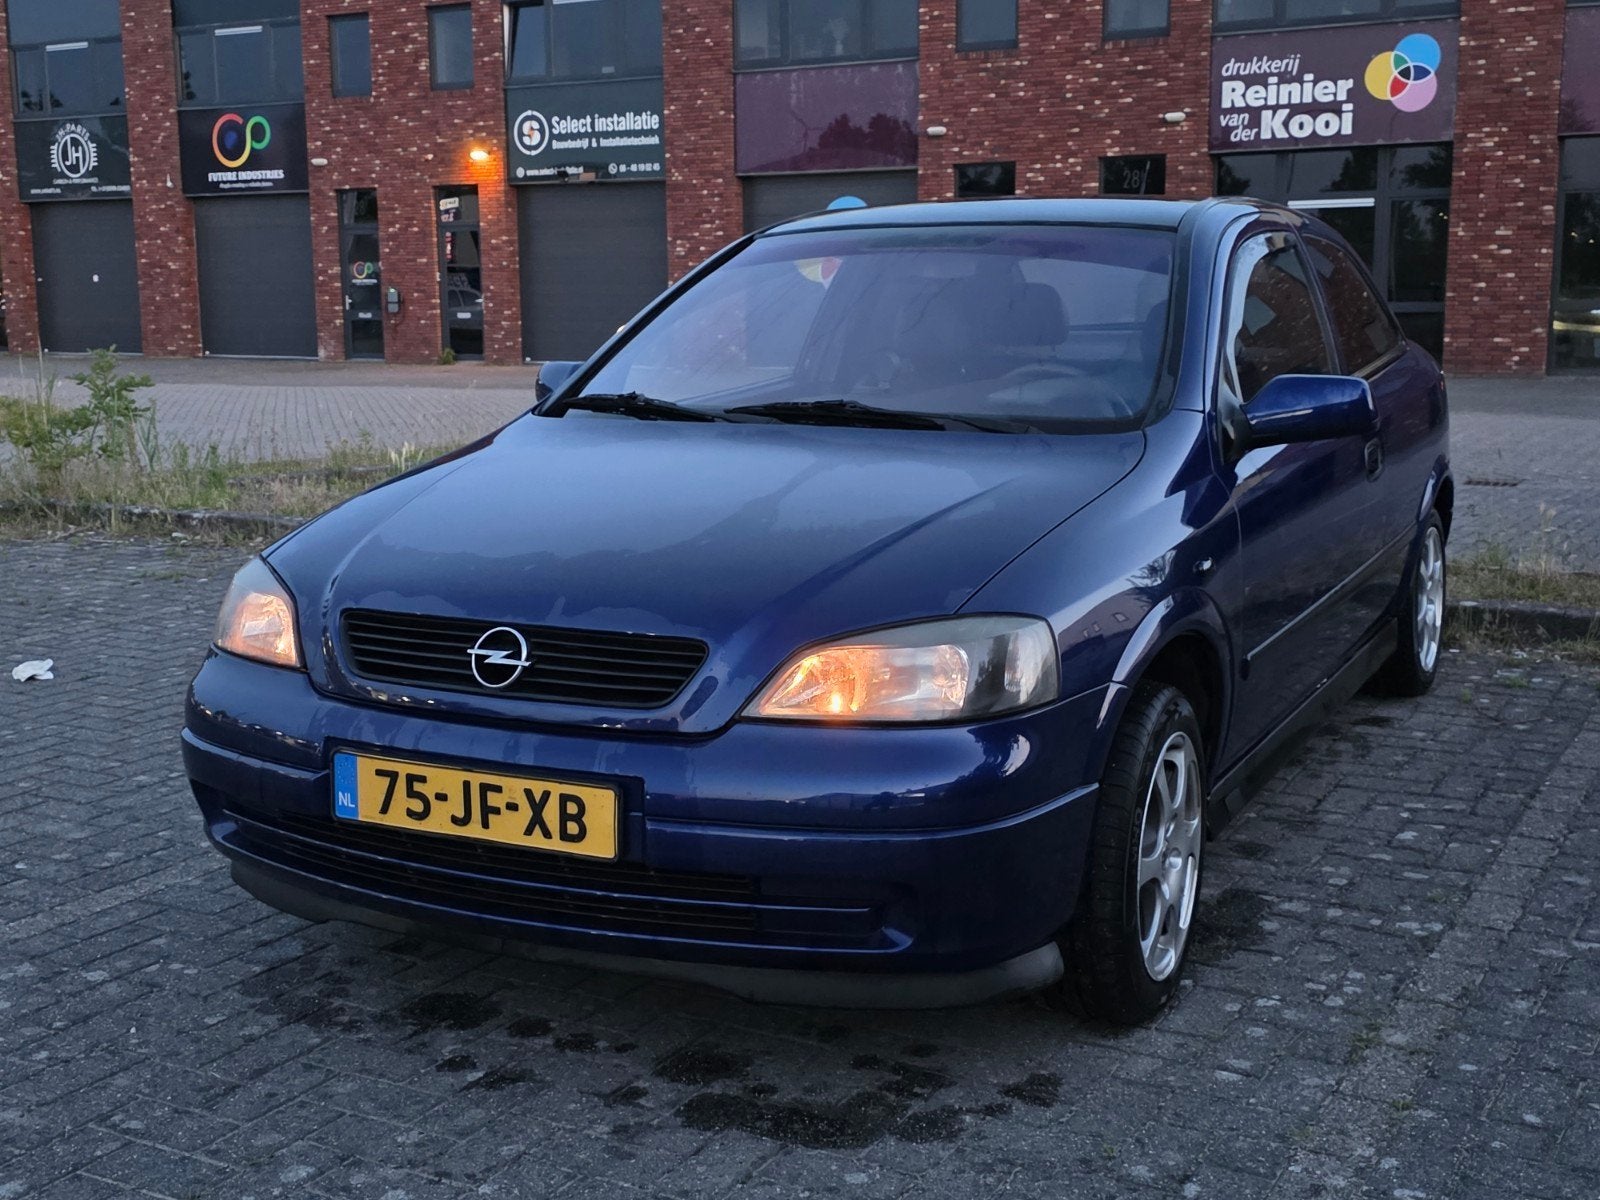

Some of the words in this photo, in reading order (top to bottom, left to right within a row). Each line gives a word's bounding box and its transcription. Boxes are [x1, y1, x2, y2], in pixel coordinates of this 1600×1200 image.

[1221, 54, 1300, 76] drukkerij
[1221, 73, 1353, 108] Reinier
[551, 114, 592, 134] Select
[594, 111, 660, 132] installatie
[1219, 112, 1249, 127] van
[1260, 103, 1353, 140] Kooi
[1230, 121, 1258, 142] der
[208, 171, 237, 182] FUTURE
[238, 169, 285, 180] INDUSTRIES
[338, 791, 356, 808] NL
[374, 768, 588, 843] 75-JF-XB
